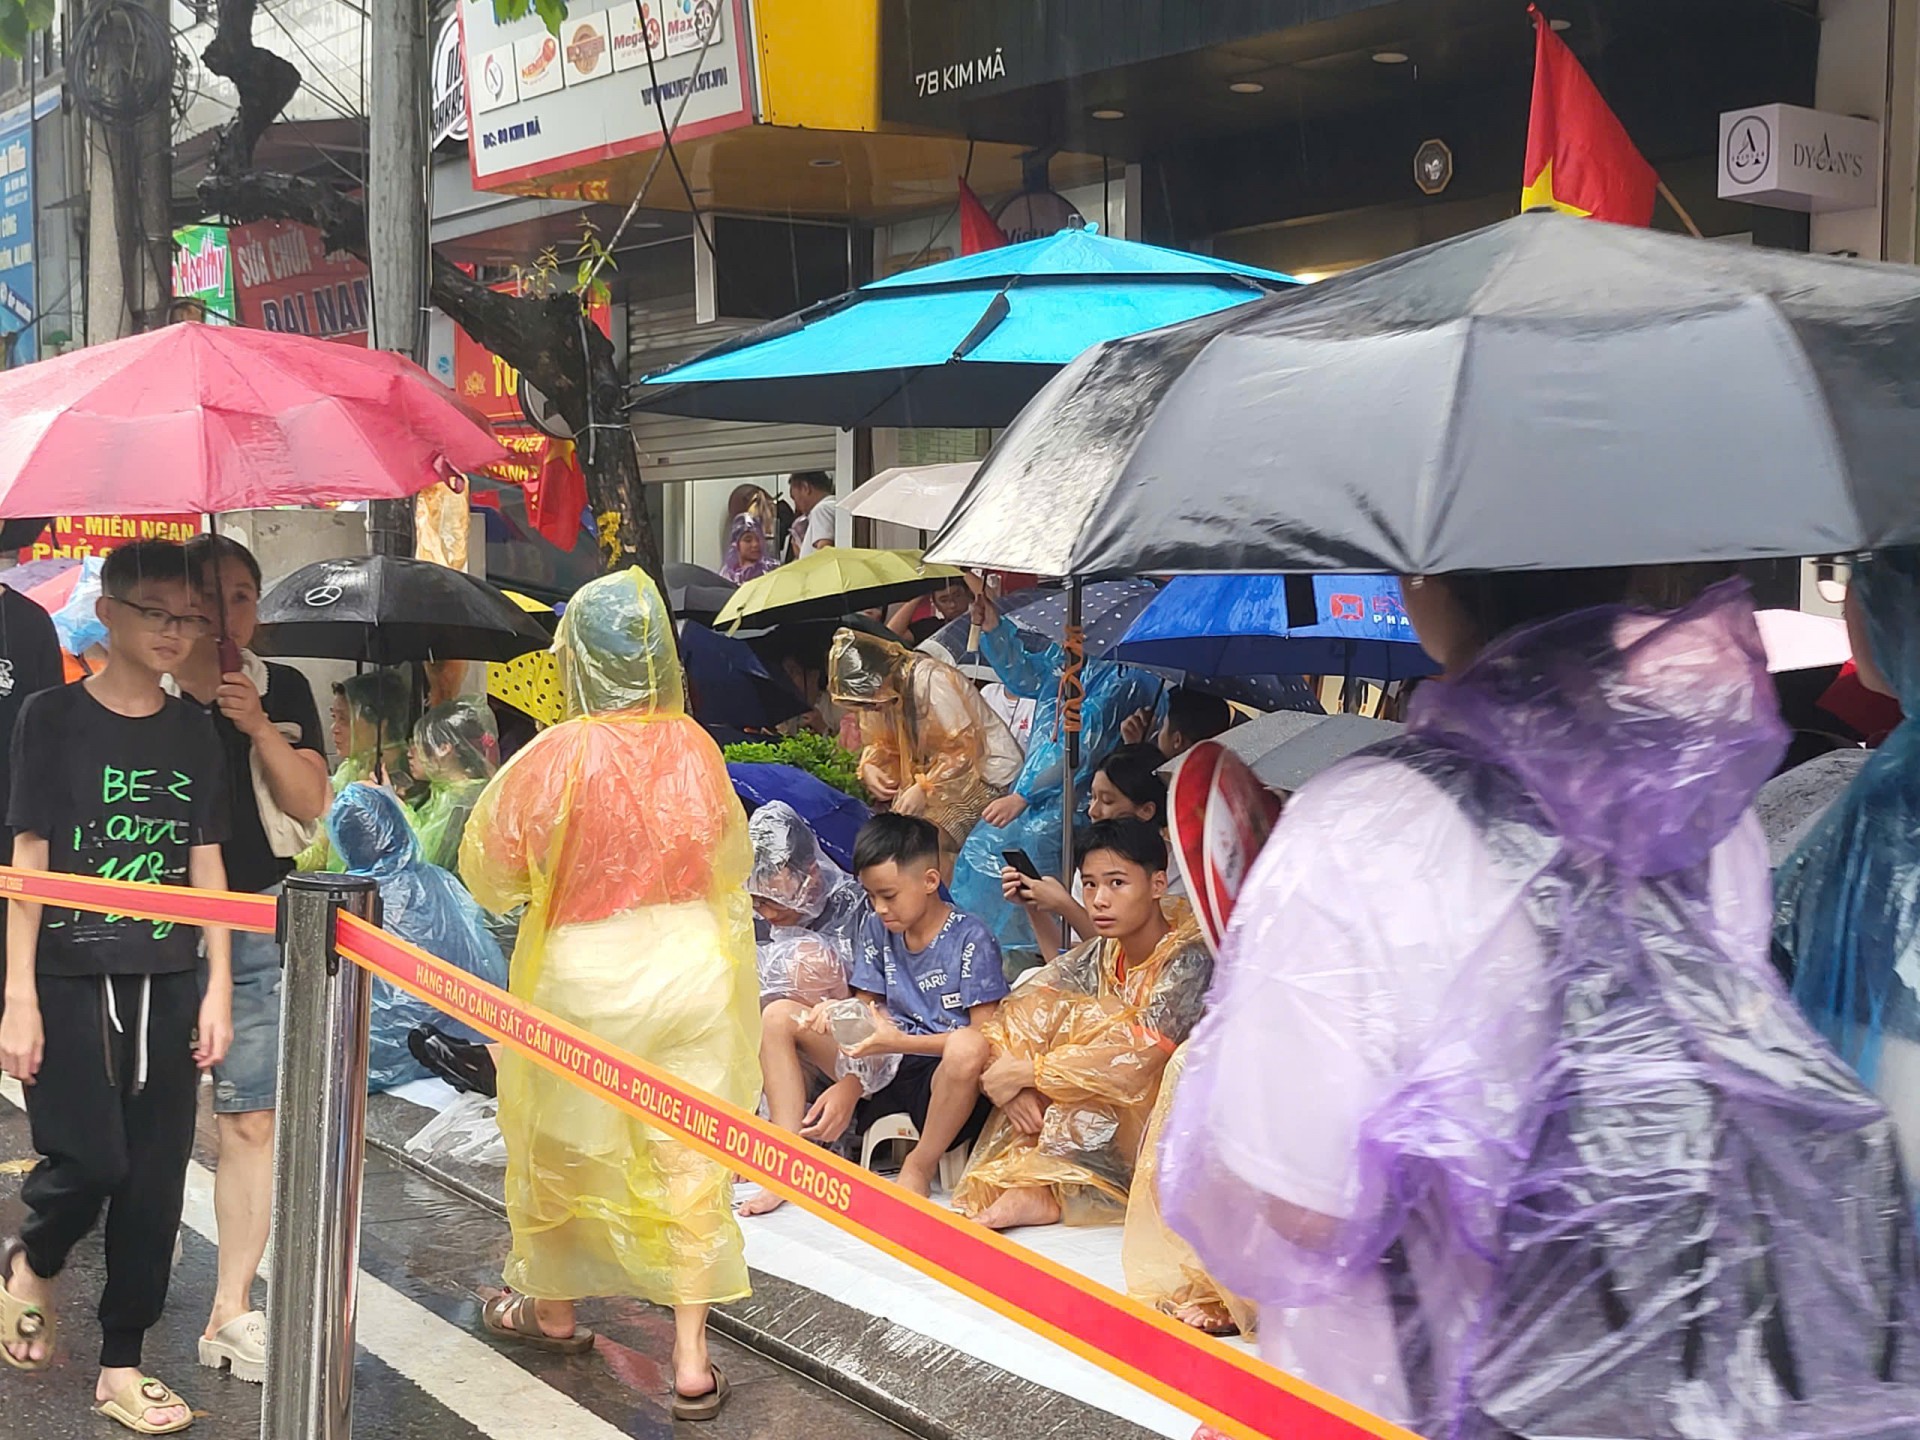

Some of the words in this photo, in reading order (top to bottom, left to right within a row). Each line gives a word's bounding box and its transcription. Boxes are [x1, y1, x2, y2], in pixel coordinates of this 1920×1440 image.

[915, 70, 939, 98] 78
[943, 60, 974, 92] KIM
[977, 47, 1006, 84] MÃ
[961, 941, 976, 979] PARIS
[416, 963, 443, 994] HÀNG
[444, 978, 467, 1009] RÀO
[500, 1007, 523, 1039] SÁT.
[593, 1058, 620, 1092] QUA
[631, 1077, 683, 1124] POLICE
[684, 1105, 721, 1145] LINE.
[725, 1126, 750, 1158] DO
[752, 1139, 789, 1177] NOT
[790, 1159, 852, 1212] CROSS
